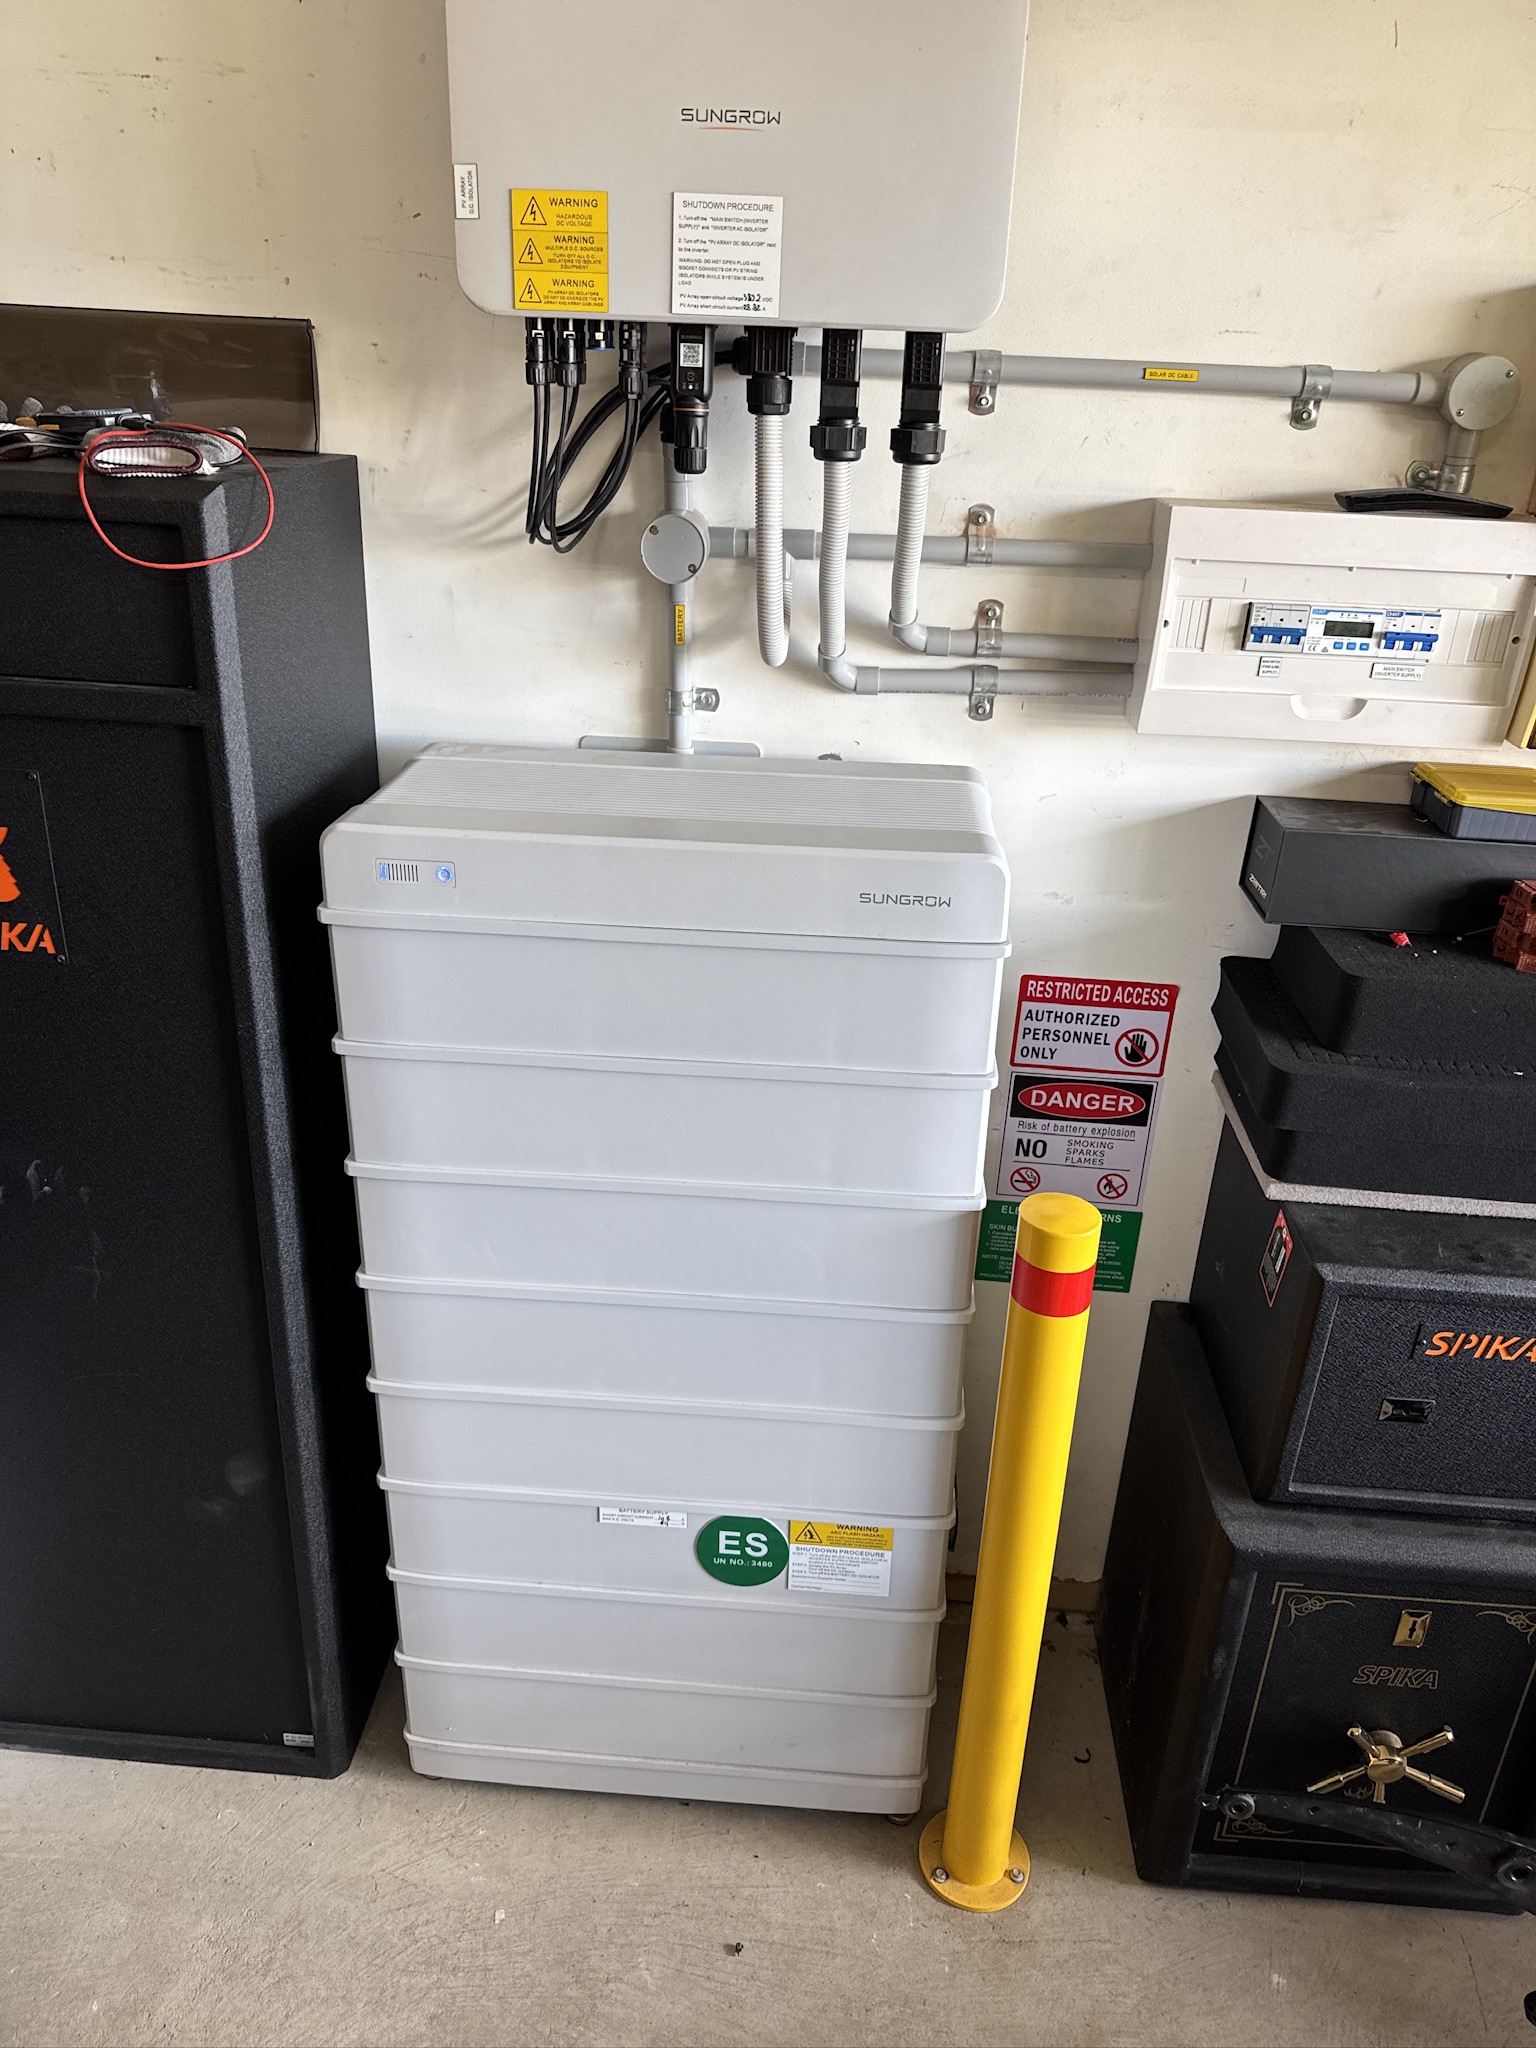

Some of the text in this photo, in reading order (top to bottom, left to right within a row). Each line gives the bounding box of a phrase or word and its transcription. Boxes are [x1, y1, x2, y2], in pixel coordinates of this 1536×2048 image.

[681, 109, 780, 124] SUNGROW
[462, 200, 466, 208] PV
[550, 198, 598, 207] WARNING
[683, 200, 773, 212] SHUTDOWN PROCEDURE
[554, 236, 594, 244] WARNING
[552, 279, 594, 287] WARNING
[860, 893, 951, 907] SUNGROW
[1027, 980, 1169, 1006] RESTRICTED ACCESS
[1025, 1009, 1120, 1027] AUTHORIZED
[1022, 1027, 1111, 1045] PERSONNEL
[1021, 1046, 1057, 1060] ONLY
[1031, 1089, 1135, 1112] DANGER
[1018, 1120, 1135, 1138] Risk of battery explosion
[1015, 1138, 1047, 1158] NO
[1067, 1140, 1114, 1149] SMOKING
[1066, 1148, 1105, 1157] SPARKS
[1065, 1157, 1104, 1165] FLAMES
[1102, 1214, 1121, 1223] RNS
[837, 1524, 878, 1532] WARNING
[719, 1530, 768, 1557] ES
[796, 1546, 885, 1558] SHUTDOWN PROCEDURE
[1352, 1665, 1438, 1689] SPIKA
